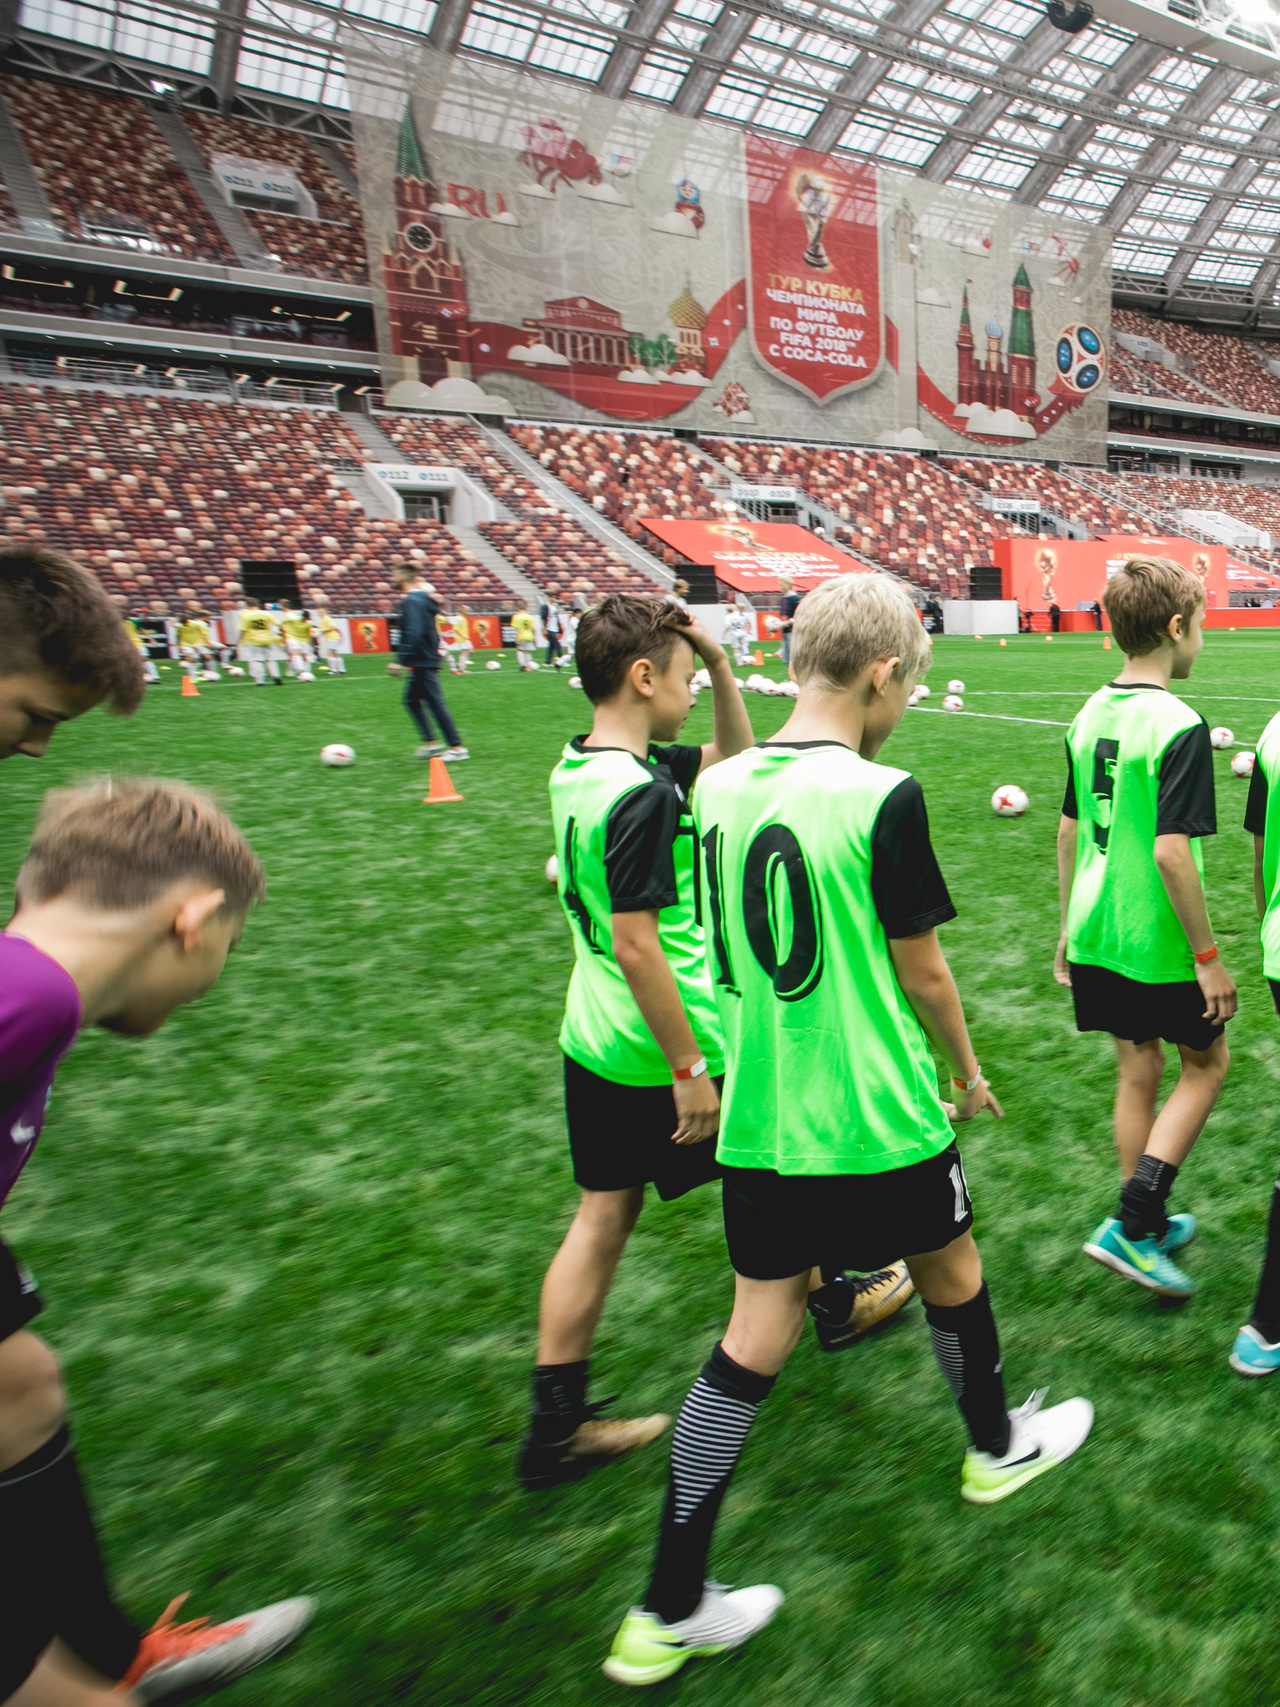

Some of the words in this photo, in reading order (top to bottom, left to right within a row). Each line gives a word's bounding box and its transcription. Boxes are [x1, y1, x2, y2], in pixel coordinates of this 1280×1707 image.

[767, 273, 802, 291] ТУР
[806, 280, 864, 302] КУБКА
[766, 288, 866, 316] ЧЕМПИОНАТА
[770, 316, 793, 331] ПО
[795, 321, 864, 341] ФУТБОЛУ
[797, 307, 838, 324] МИРА
[780, 332, 813, 348] FIFA
[783, 346, 867, 368] COCA-COLA
[701, 823, 824, 1003] 10
[949, 1155, 972, 1223] 1
